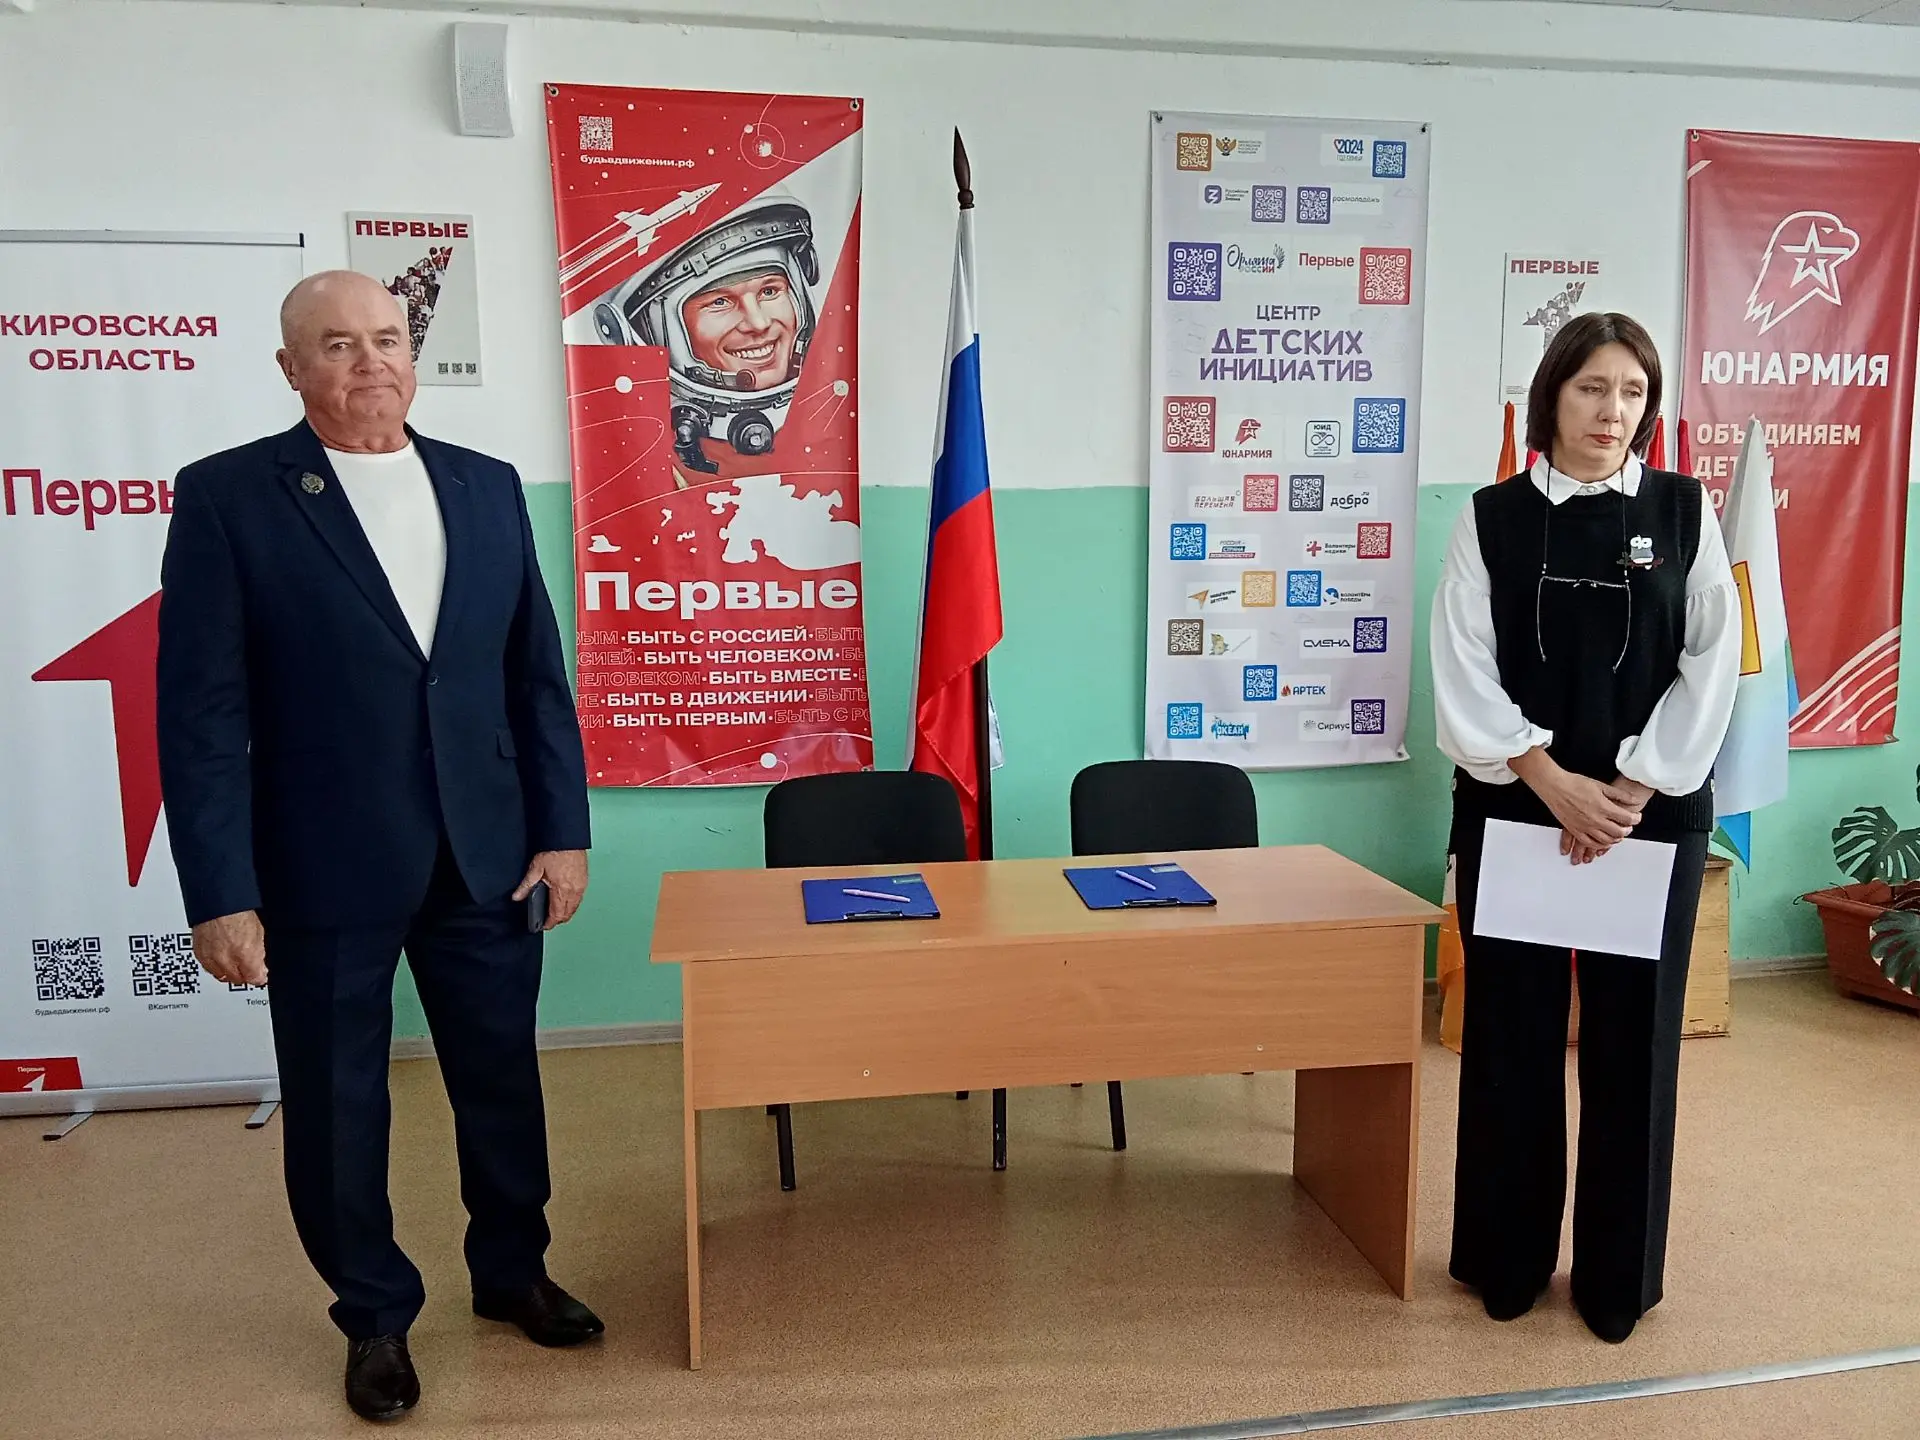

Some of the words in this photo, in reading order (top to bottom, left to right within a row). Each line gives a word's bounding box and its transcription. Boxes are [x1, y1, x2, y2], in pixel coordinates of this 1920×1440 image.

[1338, 139, 1364, 154] 2024
[580, 154, 695, 168] будьвдвижении.рф
[355, 219, 469, 238] ПЕРВЫЕ
[1299, 252, 1355, 271] Первые
[1510, 259, 1600, 275] ПЕРВЫЕ
[1256, 304, 1321, 322] ЦЕНТР
[0, 314, 218, 338] КИРОВСКАЯ
[1211, 329, 1362, 355] ДЕТСКИХ
[29, 348, 195, 372] ОБЛАСТЬ
[1701, 350, 1890, 388] ЮНАРМИЯ
[1199, 357, 1373, 384] ИНИЦИАТИВ
[1696, 423, 1861, 448] ОБЪДИНЯЕМ
[1222, 449, 1272, 458] ЮНАРМИЯ
[1331, 494, 1369, 508] добро
[584, 571, 858, 620] Первые
[577, 630, 619, 645] ЫМ
[627, 630, 686, 644] БЫТЬ
[689, 630, 704, 644] С
[709, 625, 807, 644] РОССИЕЙ
[644, 651, 702, 665] БЫТЬ
[706, 648, 833, 664] ЧЕЛОВЕКОМ
[577, 671, 701, 688] ЕЛОВЕКОМ
[709, 670, 767, 685] БЫТЬ
[770, 668, 851, 683] ВМЕСТЕ
[607, 692, 666, 707] БЫТЬ
[670, 692, 684, 706] В
[687, 689, 807, 708] ДВИЖЕНИИ
[1293, 685, 1326, 695] АРТЕК
[613, 713, 672, 728] БЫТЬ
[675, 711, 766, 726] ПЕРВЫМ
[774, 708, 831, 724] БЫТЬ
[833, 707, 848, 722] С
[1318, 722, 1350, 731] Сириус
